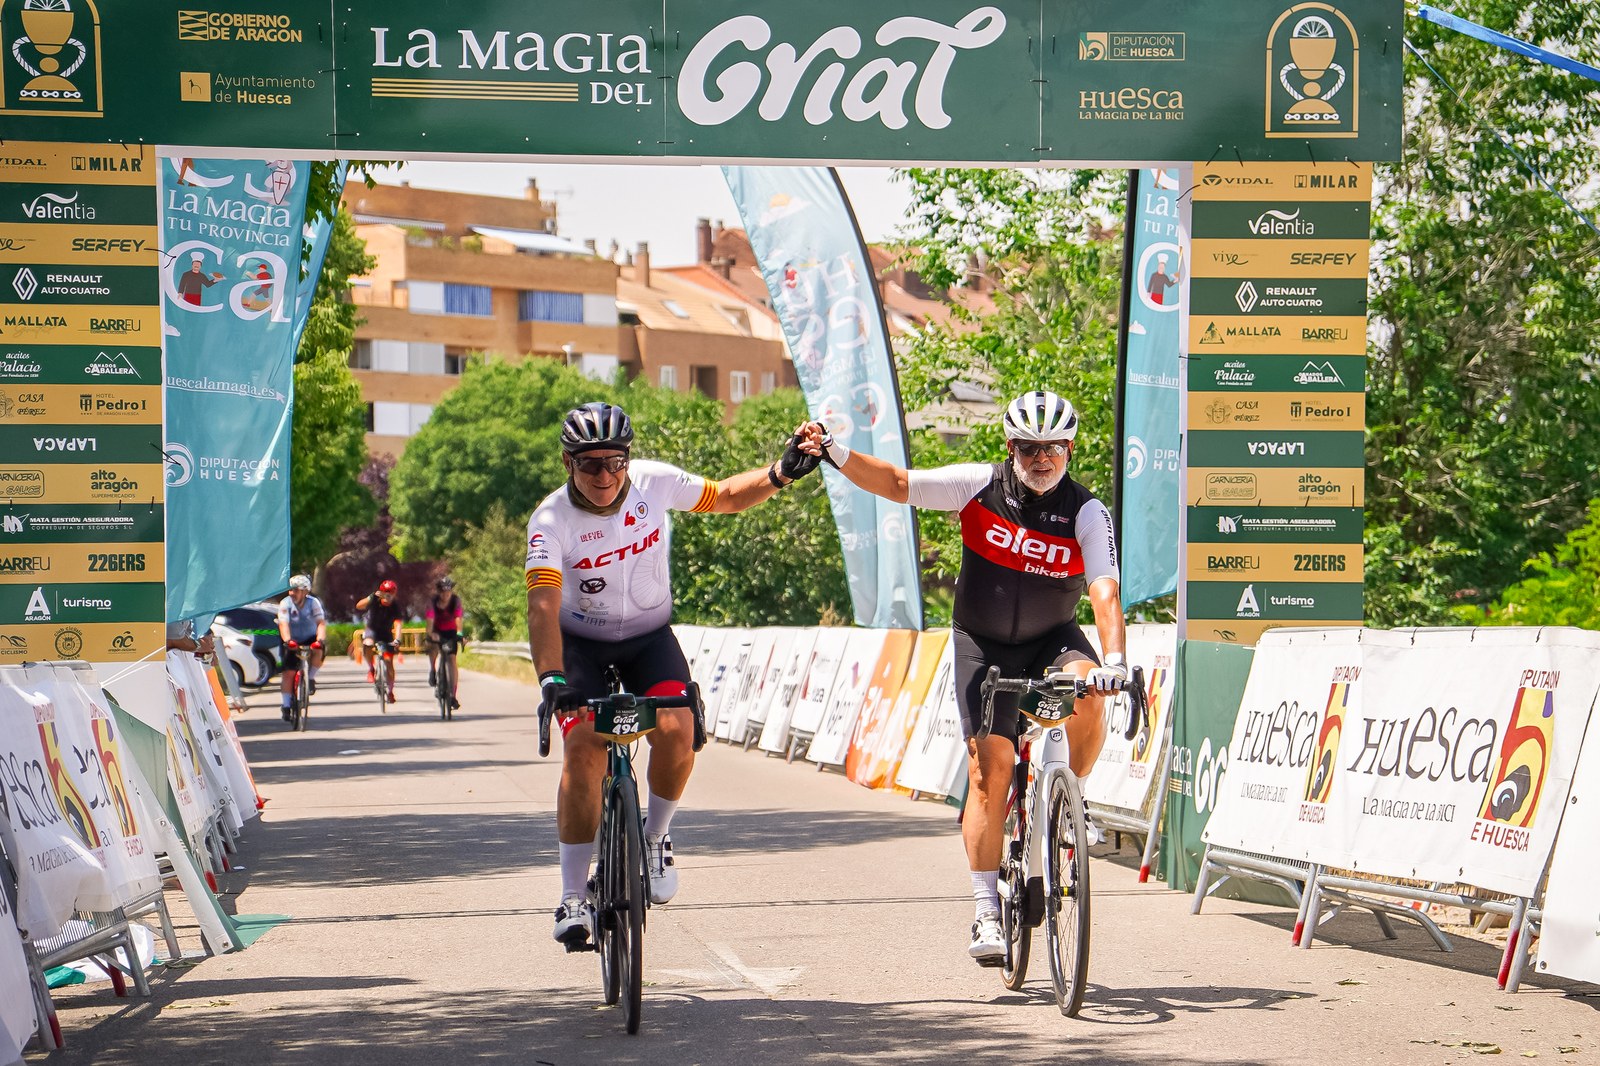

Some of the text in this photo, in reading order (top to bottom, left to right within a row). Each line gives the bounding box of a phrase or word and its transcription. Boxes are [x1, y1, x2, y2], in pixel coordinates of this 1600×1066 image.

[209, 13, 290, 28] GOBIERNO
[209, 27, 230, 40] DE
[1113, 34, 1175, 46] DIPUTACIÓN
[1113, 47, 1175, 57] DE HUESCA
[214, 73, 315, 89] Ayuntamiento
[215, 90, 292, 104] de Huesca
[1165, 112, 1184, 121] BICI
[89, 157, 141, 172] MILAR
[1224, 177, 1274, 185] VIDAL
[1310, 175, 1358, 188] MILAR
[22, 191, 96, 220] Valentia
[168, 217, 191, 231] TU
[1144, 220, 1161, 234] TU
[1248, 207, 1314, 235] Valentia
[72, 238, 145, 252] SERFEY
[1290, 253, 1357, 265] SERFEY
[47, 275, 103, 283] RENAULT
[41, 287, 110, 295] AUTO CUATRO
[1266, 287, 1317, 295] RENAULT
[1286, 299, 1323, 307] CUATRO
[5, 316, 67, 326] MALLATA
[90, 318, 141, 331] BARREU
[1226, 327, 1281, 336] MALLATA
[1302, 328, 1348, 340] BARREU
[85, 364, 134, 376] CABALLERA
[1213, 368, 1256, 381] Palacio
[1293, 373, 1339, 384] CABALLERA
[167, 376, 275, 397] uescalamagia.es
[18, 394, 44, 403] CASA
[96, 399, 146, 410] Pedro I
[1236, 401, 1259, 409] CASA
[1305, 406, 1351, 417] Pedro I
[33, 437, 96, 451] LAPACA
[1248, 442, 1305, 455] LAPACA
[0, 473, 41, 481] RNICERIA
[90, 469, 116, 480] alto
[200, 469, 279, 480] HUESCA
[1298, 473, 1322, 484] alto
[572, 528, 659, 569] ACTUR
[986, 524, 1071, 564] alen
[88, 554, 145, 572] 226ERS
[1207, 556, 1260, 569] BARREU
[1294, 555, 1346, 572] 226ERS
[1024, 563, 1069, 578] bikes
[63, 597, 112, 607] turismo
[1270, 595, 1314, 605] turismo
[1035, 708, 1061, 720] 122
[612, 722, 639, 735] 494
[1481, 824, 1530, 851] HUESCA
